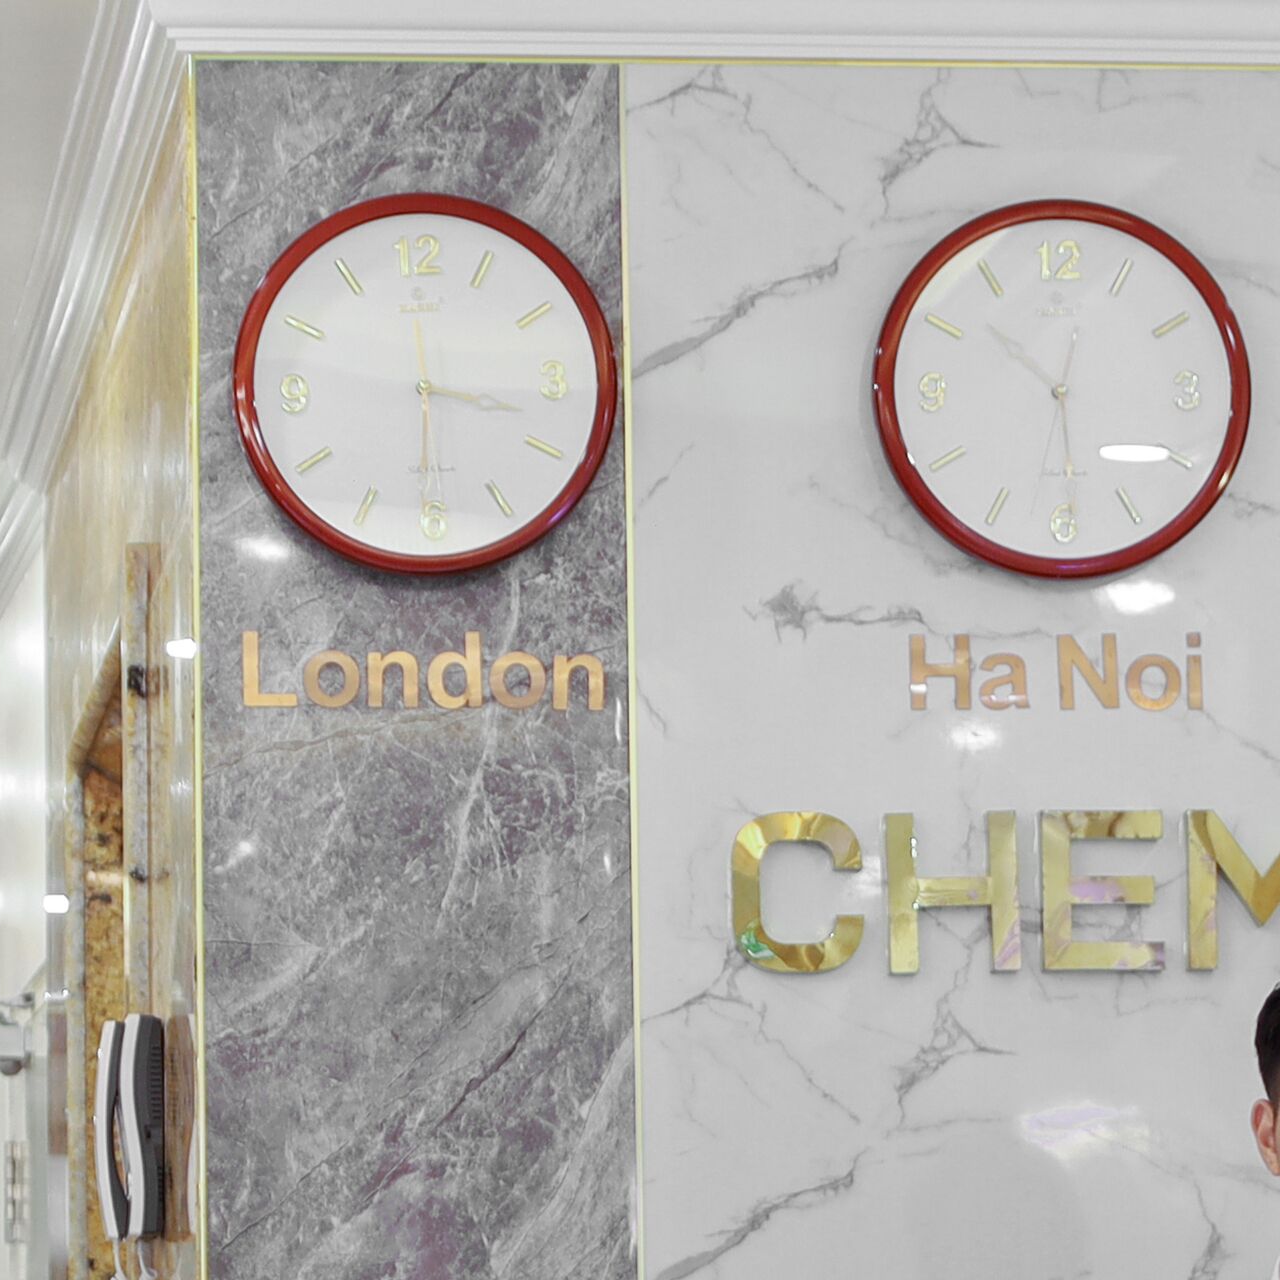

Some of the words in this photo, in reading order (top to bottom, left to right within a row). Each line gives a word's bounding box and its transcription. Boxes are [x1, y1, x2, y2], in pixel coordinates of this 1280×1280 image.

[393, 235, 442, 277] 12
[1036, 240, 1081, 281] 12
[279, 374, 311, 413] 9
[539, 361, 569, 399] 3
[919, 373, 948, 412] 9
[1173, 370, 1200, 410] 3
[419, 501, 448, 540] 6
[1050, 504, 1079, 543] 6
[241, 630, 606, 711] London
[908, 632, 1031, 711] Ha
[1056, 631, 1204, 711] Noi
